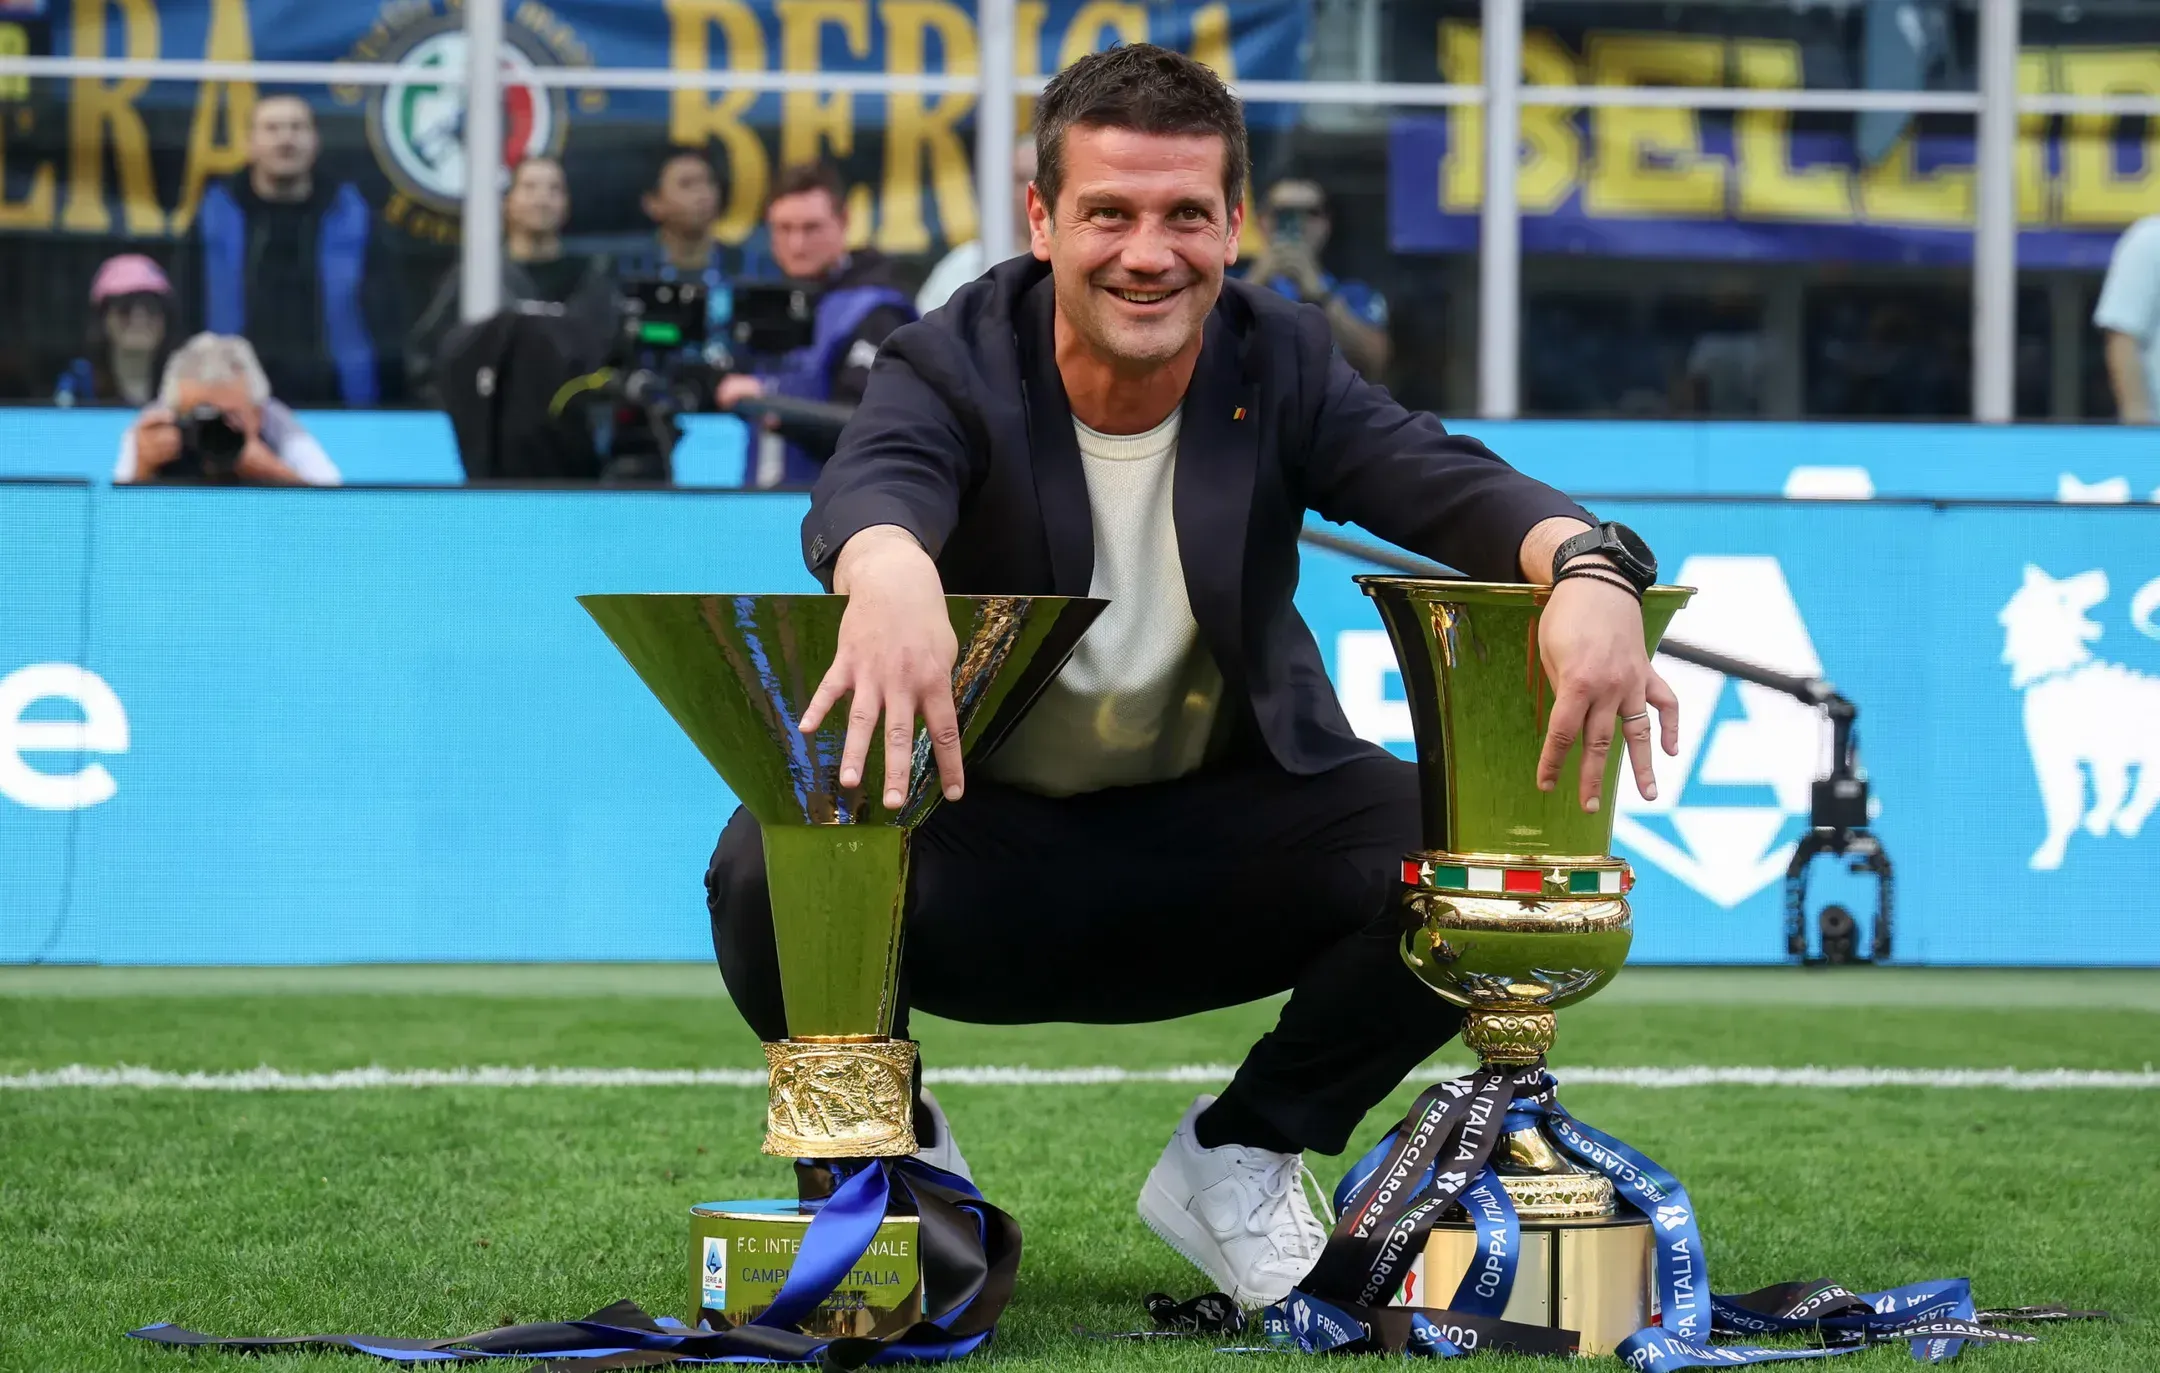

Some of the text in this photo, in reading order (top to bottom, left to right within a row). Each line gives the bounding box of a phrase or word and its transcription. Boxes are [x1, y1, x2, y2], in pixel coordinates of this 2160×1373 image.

[1454, 1096, 1495, 1161] ITALIA
[1550, 1111, 1666, 1203] FRECCIAROSSA
[1353, 1100, 1451, 1240] FRECCIAROSSA
[737, 1236, 909, 1257] F.C. INTENALE
[742, 1267, 900, 1286] CAMPI ITALIA
[1355, 1198, 1444, 1308] FRECCIAROSSA
[1470, 1184, 1507, 1298] COPPA ITALIA
[1671, 1237, 1696, 1310] ITALIA
